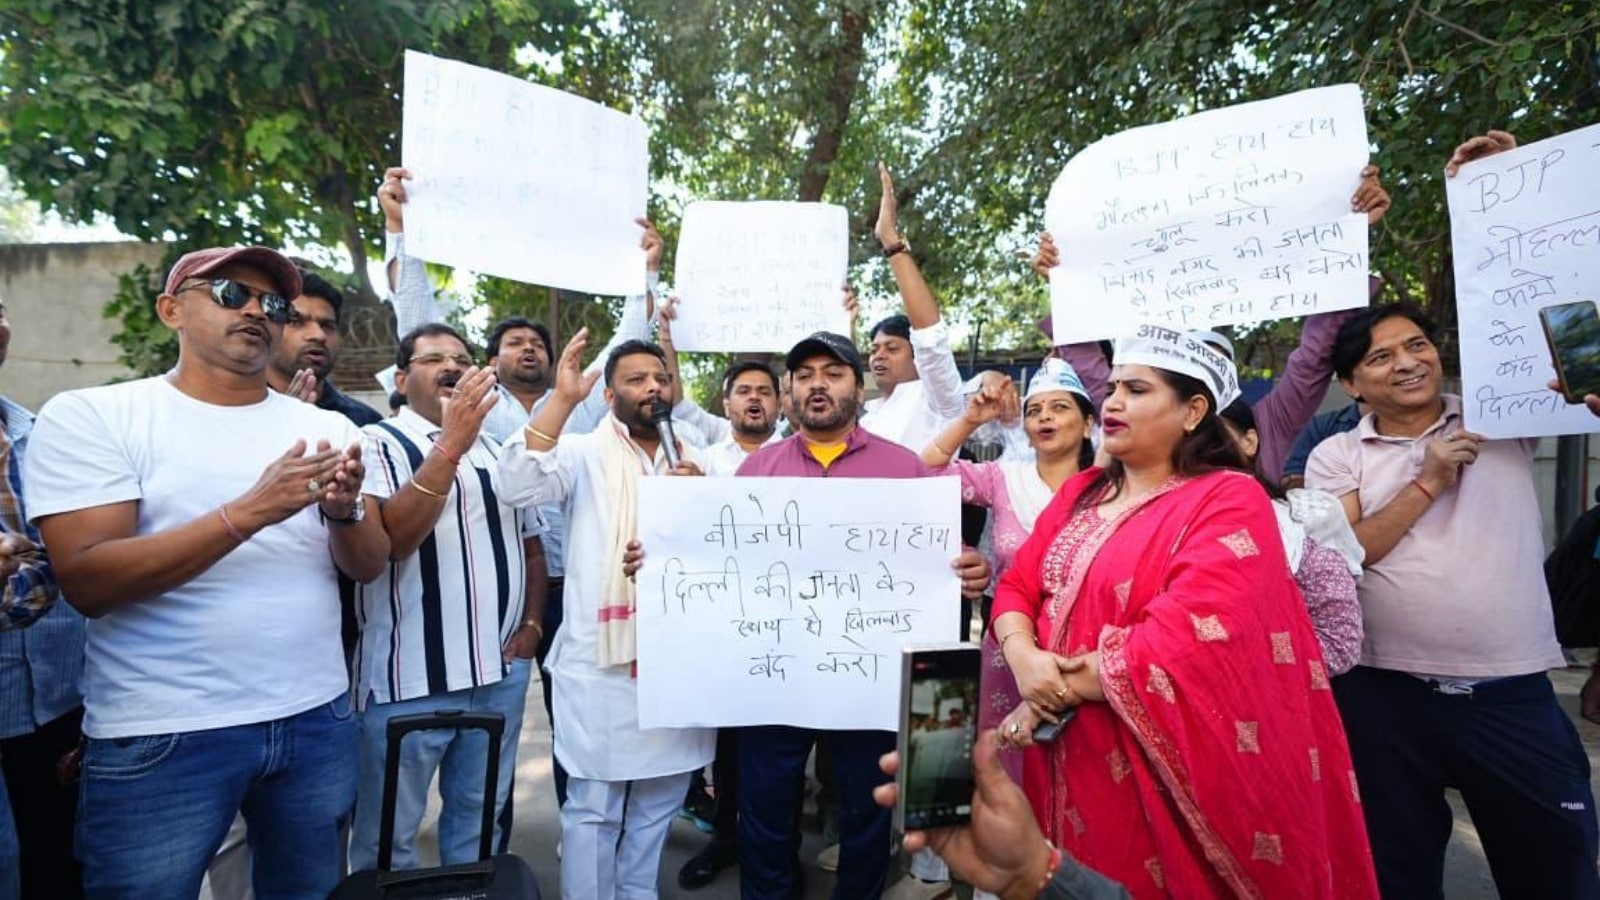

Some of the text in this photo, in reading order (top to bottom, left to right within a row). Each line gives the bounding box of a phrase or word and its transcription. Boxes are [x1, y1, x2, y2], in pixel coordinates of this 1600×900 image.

[1466, 149, 1565, 214] BJP
[1137, 324, 1182, 345] आम
[1185, 338, 1228, 376] आदमी
[829, 523, 897, 552] हाय
[901, 522, 950, 551] हाय
[662, 556, 915, 617] दिल्ली की जनता के
[748, 635, 889, 682] बंद करो
